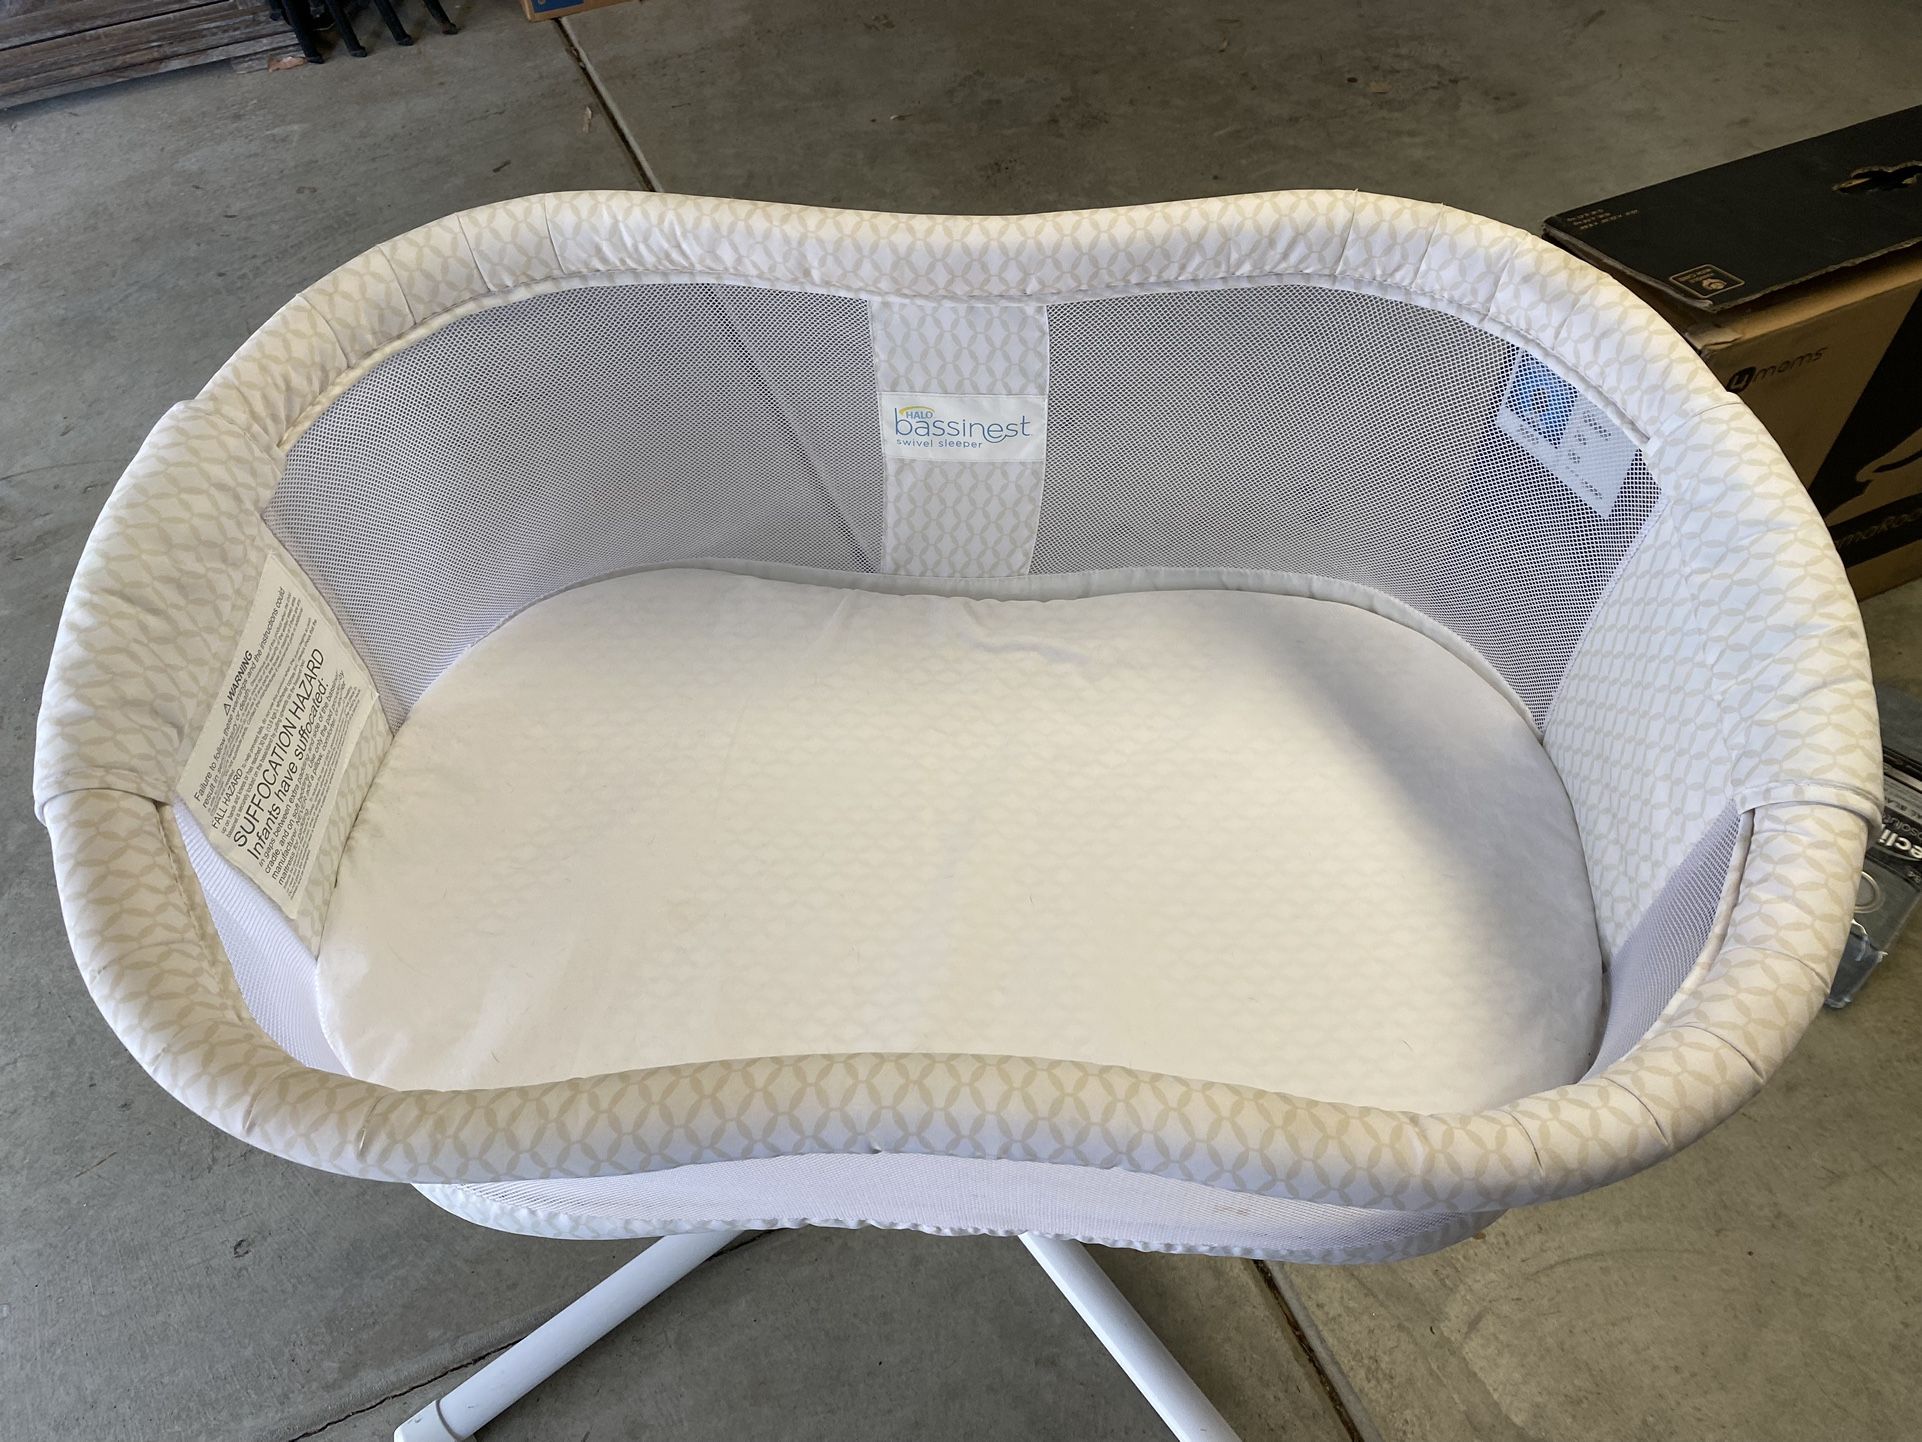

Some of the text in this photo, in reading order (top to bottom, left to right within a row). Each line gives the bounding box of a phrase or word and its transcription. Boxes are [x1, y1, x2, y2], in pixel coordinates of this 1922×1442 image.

[894, 407, 1032, 443] bassinest
[905, 411, 933, 420] HALO
[896, 438, 983, 449] swivel sleeper
[226, 648, 252, 702] WARNING
[193, 769, 212, 802] Failure
[208, 758, 216, 772] to
[213, 735, 226, 761] follow
[222, 713, 234, 737] these
[231, 677, 248, 713] warnings
[245, 659, 256, 680] and
[253, 646, 262, 663] the
[259, 606, 278, 650] instructions
[274, 585, 285, 609] could
[320, 699, 328, 715] the
[311, 721, 320, 739] side
[317, 711, 324, 723] of
[232, 716, 297, 852] SUFFOCATION
[288, 644, 325, 722] HAZARD
[306, 737, 314, 753] and
[246, 799, 281, 862] Infants
[273, 758, 298, 802] have
[293, 673, 329, 762] suffocated:
[201, 782, 215, 809] result
[212, 772, 219, 784] in
[211, 802, 227, 830] FALL
[221, 765, 243, 807] HAZARD
[264, 843, 282, 875] cradle,
[278, 827, 289, 848] and
[286, 816, 294, 831] on
[290, 800, 300, 818] soft
[313, 735, 323, 755] only
[319, 722, 327, 738] the
[324, 708, 333, 726] pad
[288, 781, 299, 805] extra
[272, 802, 291, 838] between
[262, 834, 276, 861] gaps
[277, 849, 295, 886] mattress
